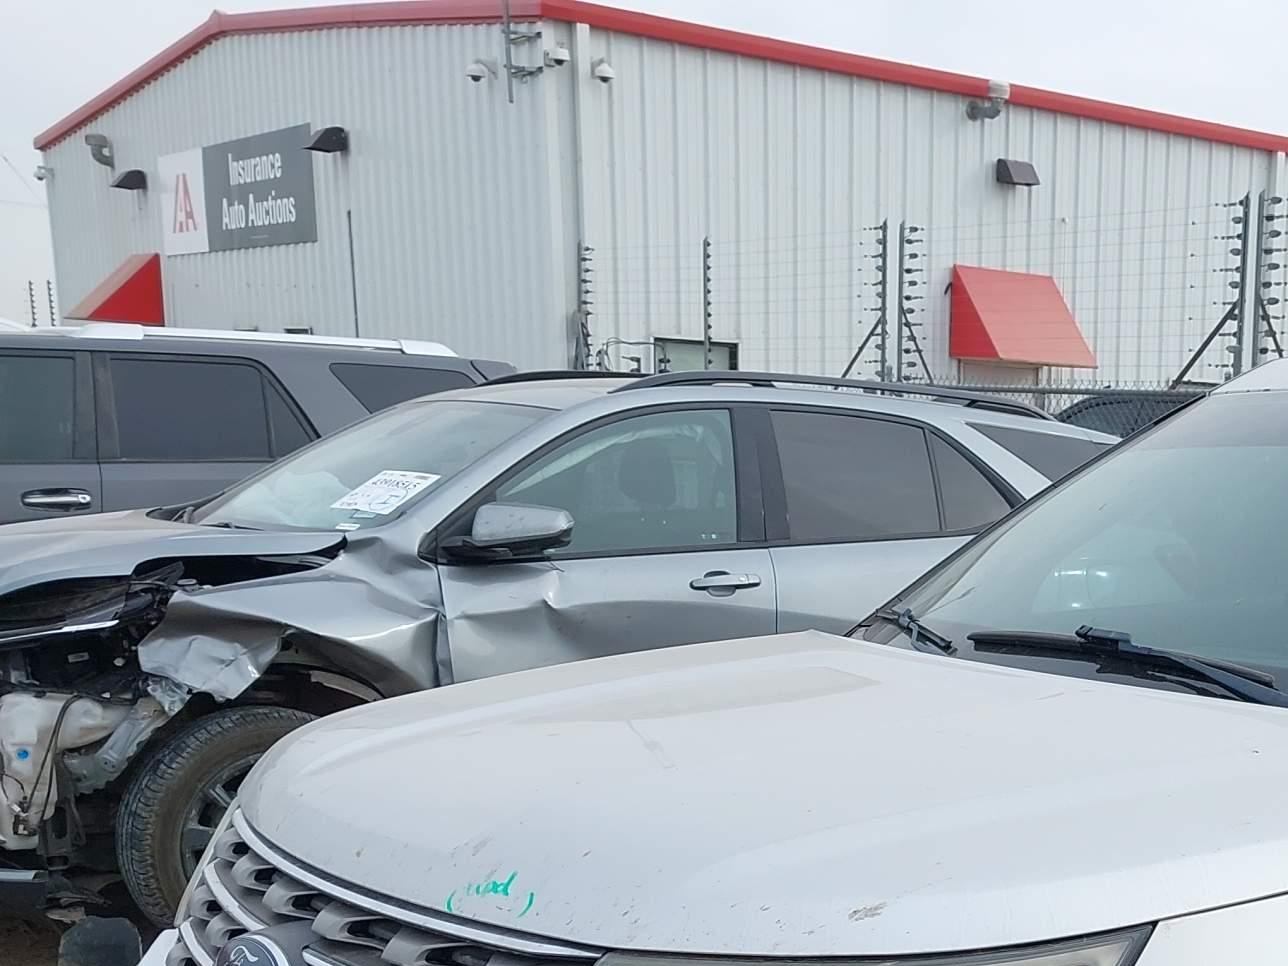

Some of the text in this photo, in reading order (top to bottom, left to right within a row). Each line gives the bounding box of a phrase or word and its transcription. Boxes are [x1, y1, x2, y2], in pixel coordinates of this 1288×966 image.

[227, 152, 283, 187] Insurance
[221, 189, 297, 231] Auto Auctions
